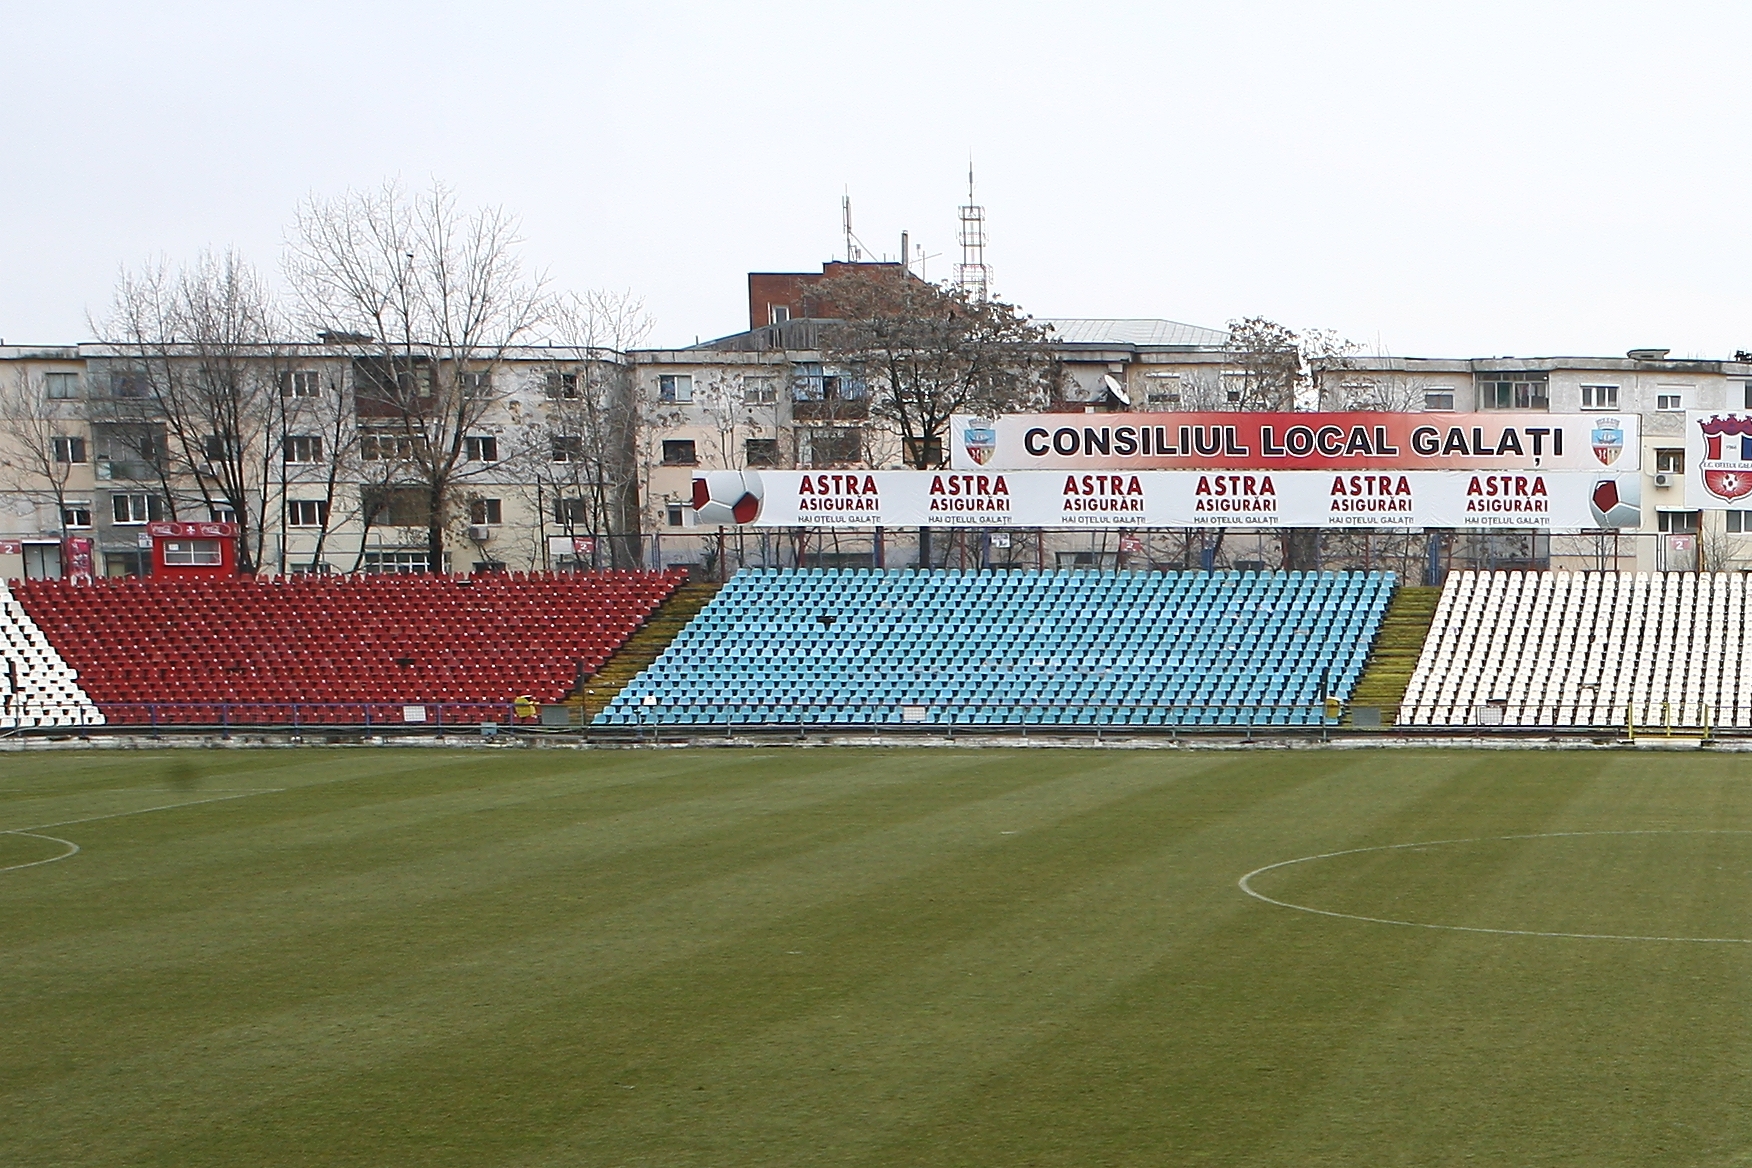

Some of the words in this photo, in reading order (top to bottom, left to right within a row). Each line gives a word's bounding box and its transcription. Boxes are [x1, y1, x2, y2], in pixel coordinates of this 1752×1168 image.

[1023, 426, 1248, 457] CONSILIUL
[1261, 426, 1398, 457] LOCAL
[1410, 426, 1563, 466] GALAȚI
[799, 475, 879, 496] ASTRA
[930, 475, 1010, 496] ASTRA
[1063, 475, 1143, 496] ASTRA
[1196, 475, 1276, 496] ASTRA
[1331, 475, 1411, 496] ASTRA
[1467, 475, 1547, 496] ASTRA
[799, 497, 880, 512] ASIGURĂRI
[930, 497, 1011, 512] ASIGURĂRI
[1063, 497, 1144, 512] ASIGURĂRI
[1196, 497, 1277, 512] ASIGURĂRI
[1331, 497, 1412, 512] ASIGURĂRI
[1467, 497, 1548, 512] ASIGURĂRI
[798, 515, 812, 524] HAI
[929, 515, 943, 524] HAI
[1062, 515, 1076, 524] HAI
[1194, 515, 1208, 524] HAI
[1329, 515, 1343, 524] HAI
[1465, 515, 1480, 524] HAI
[1675, 540, 1684, 550] 2
